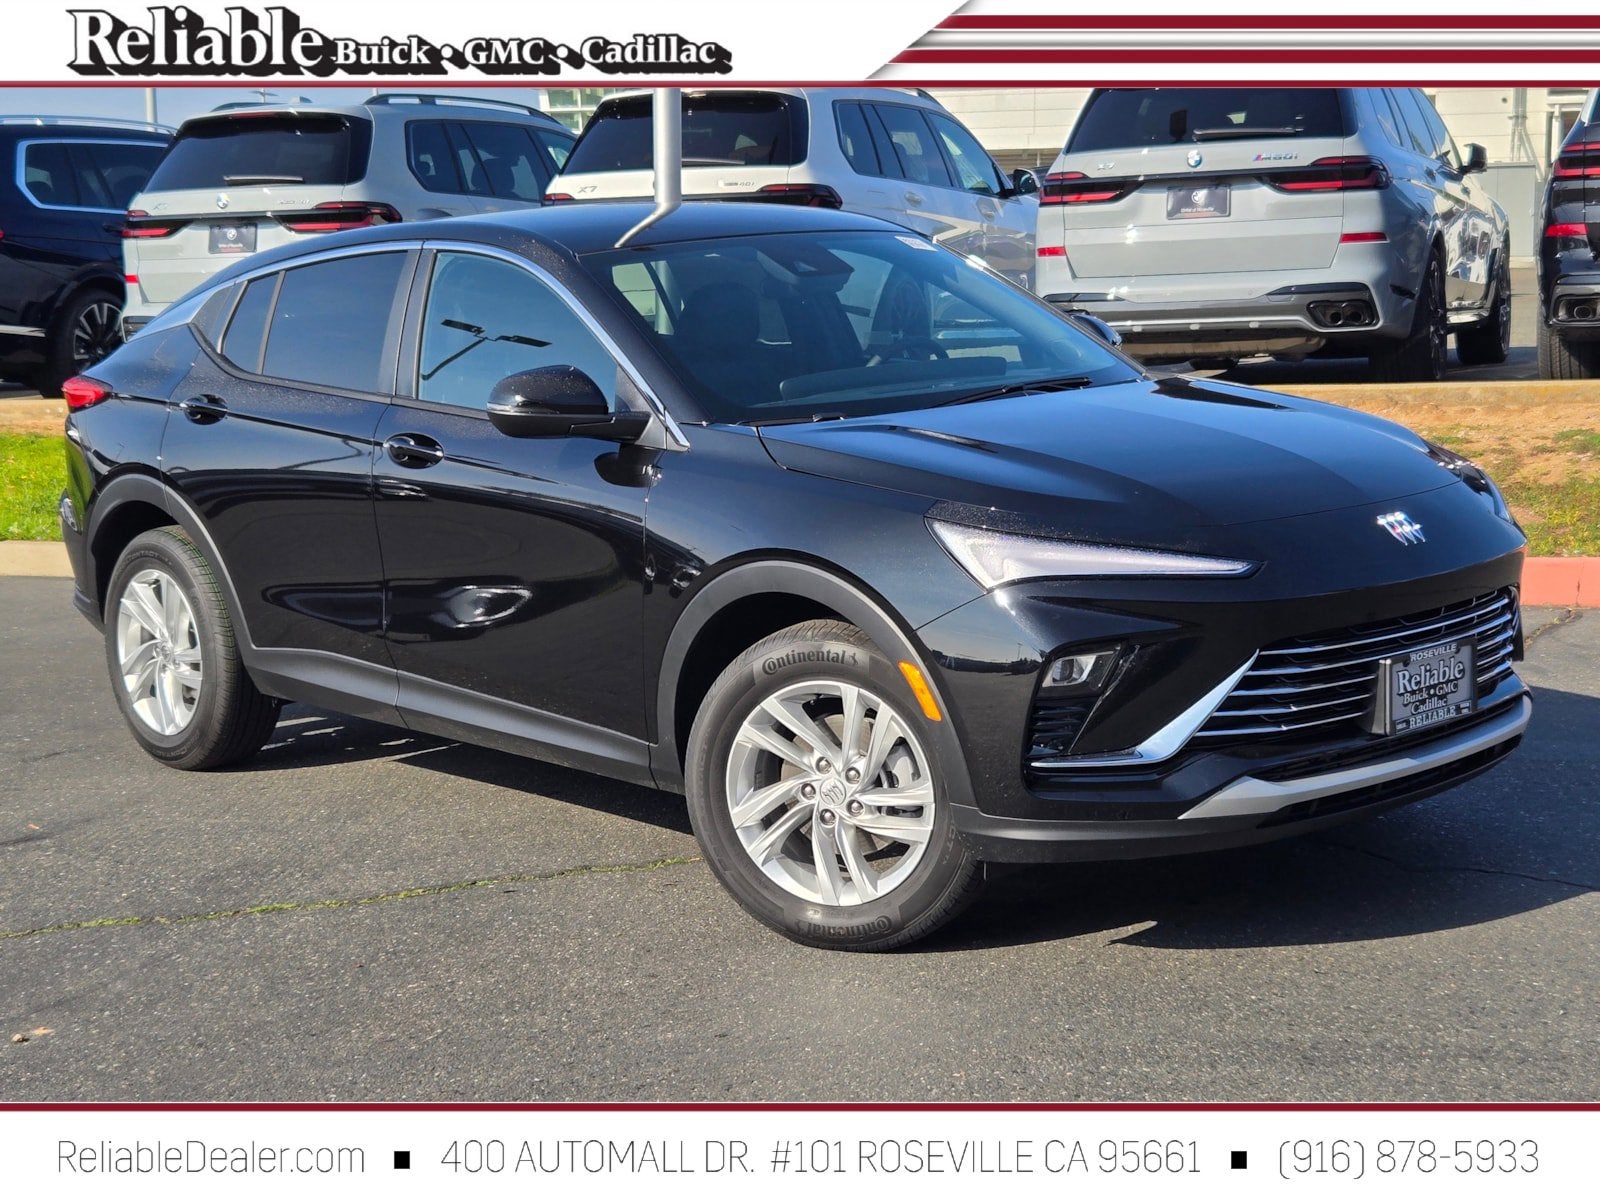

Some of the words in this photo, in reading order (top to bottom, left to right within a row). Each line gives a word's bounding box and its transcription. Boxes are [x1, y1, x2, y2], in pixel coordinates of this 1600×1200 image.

[577, 185, 598, 194] X7
[762, 649, 847, 675] Continental
[1410, 643, 1458, 662] ROSEVILLE
[1397, 656, 1464, 694] Reliable
[1403, 687, 1429, 705] Buick
[1435, 680, 1458, 696] GMC
[1409, 705, 1457, 729] RELIABLE
[1411, 696, 1447, 714] Cadillac
